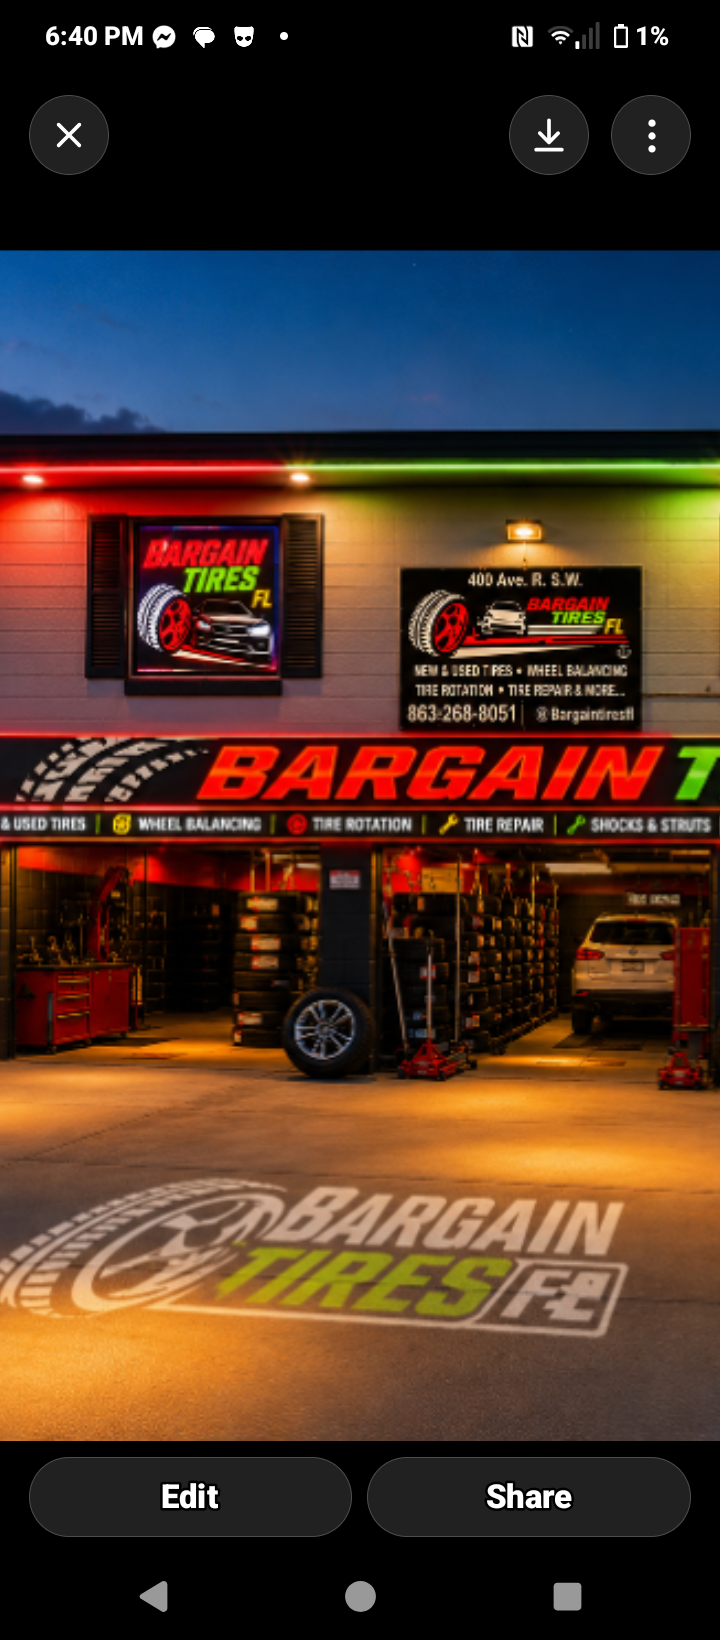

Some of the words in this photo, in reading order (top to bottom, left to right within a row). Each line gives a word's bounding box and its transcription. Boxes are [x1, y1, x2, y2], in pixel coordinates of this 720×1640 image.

[143, 539, 268, 568] BARGAIN
[183, 565, 261, 593] TIRES
[467, 571, 494, 587] 400
[496, 571, 528, 587] Ave.
[531, 571, 547, 587] R.
[551, 571, 583, 587] S.W.
[251, 588, 272, 608] FL
[526, 597, 610, 611] BARGAIN
[551, 610, 607, 625] TIRES
[603, 616, 624, 635] FL
[526, 664, 564, 677] WHEEL
[566, 664, 628, 677] BALANCING
[415, 684, 439, 697] TIRE
[441, 684, 494, 697] ROTATION
[507, 684, 532, 697] TIRE
[534, 684, 573, 697] REPAIR
[574, 684, 583, 697] &
[407, 703, 516, 723] 863-268-8051
[196, 746, 664, 800] BARGAIN
[0, 816, 11, 831] &
[13, 816, 49, 831] USED
[51, 816, 86, 831] TIRES
[138, 817, 182, 832] WHEEL
[185, 817, 262, 832] BALANCING
[312, 817, 342, 832] TIRE
[345, 817, 412, 832] ROTATION
[464, 817, 493, 833] TIRE
[496, 817, 544, 833] REPAIR
[591, 817, 644, 833] SHOCKS
[646, 817, 658, 833] &
[660, 817, 712, 833] STRUTS
[262, 1186, 625, 1256] BARGAIN
[216, 1246, 513, 1318] TIRES
